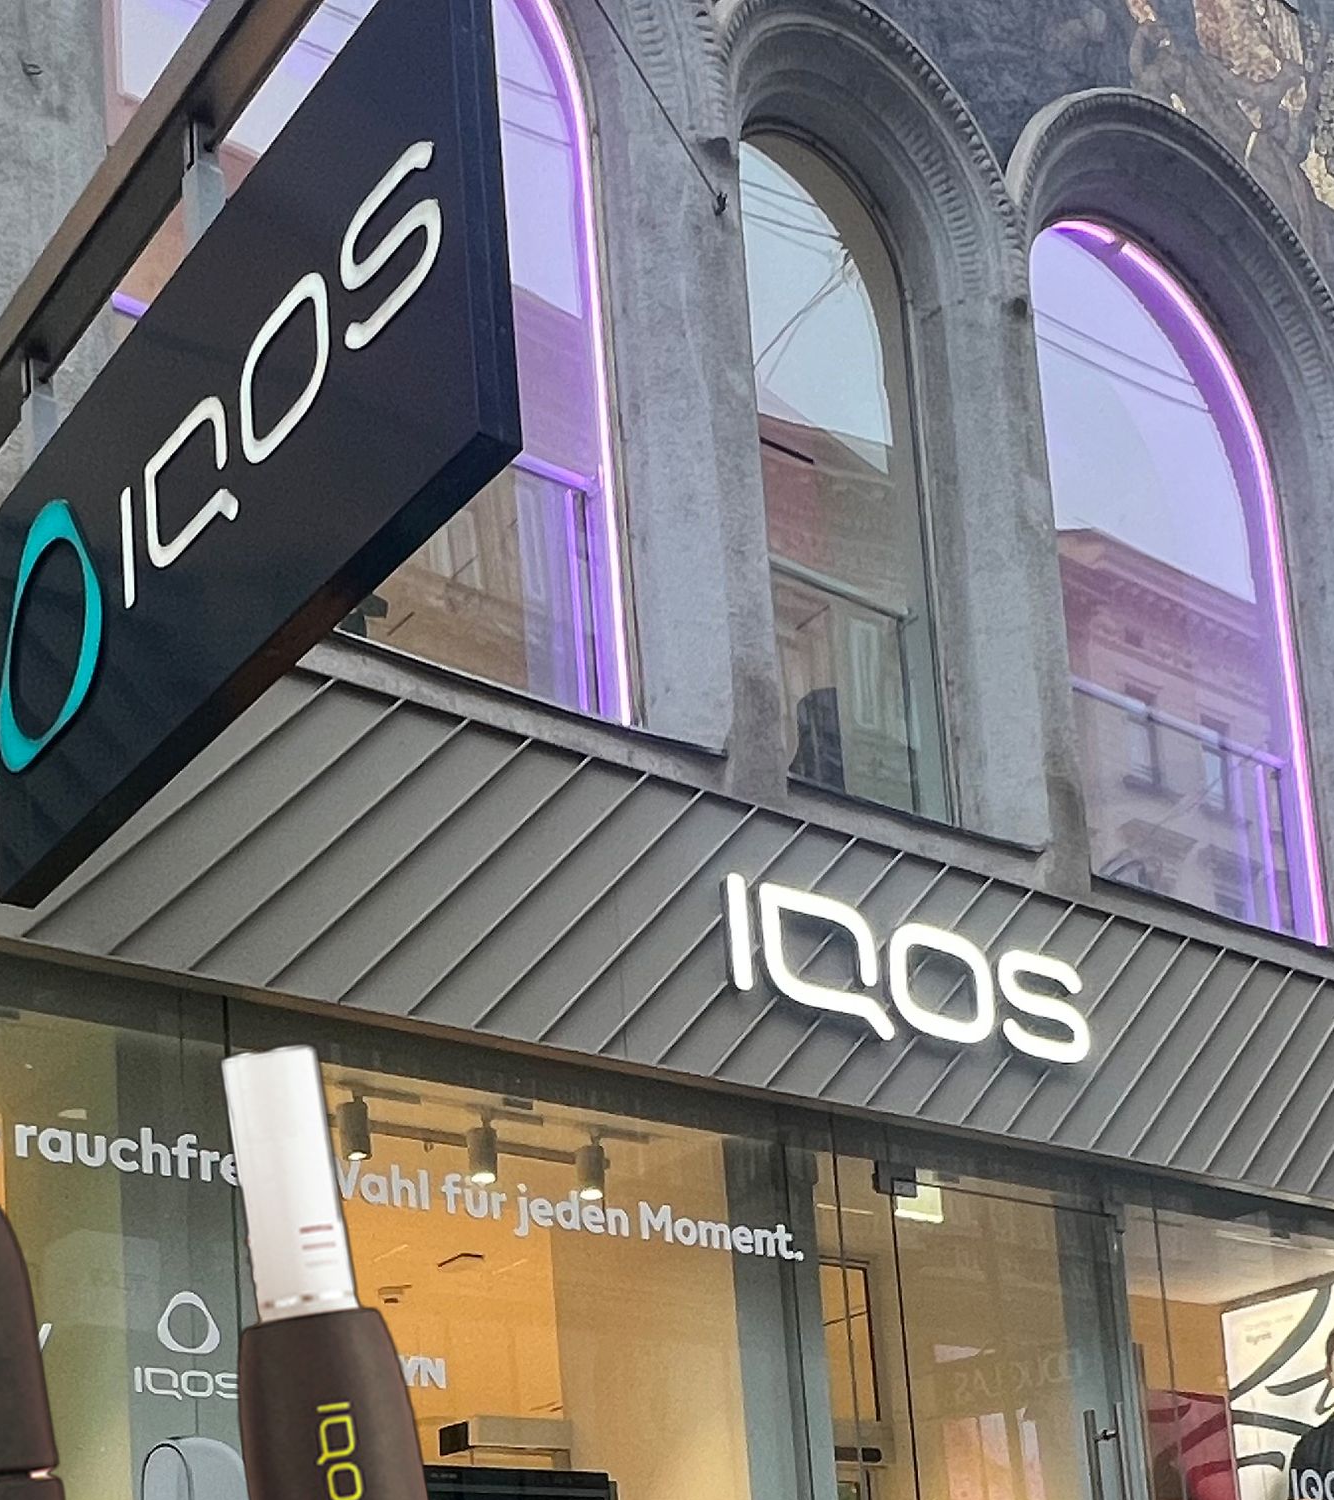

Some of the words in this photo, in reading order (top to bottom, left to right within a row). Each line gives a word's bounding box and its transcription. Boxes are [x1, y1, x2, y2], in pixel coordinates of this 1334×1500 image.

[119, 140, 441, 608] IQOS
[725, 872, 1091, 1064] IQOS
[14, 1124, 241, 1187] rauchfre
[441, 1173, 507, 1220] für
[514, 1183, 630, 1238] jeden
[639, 1200, 805, 1262] Moment.
[133, 1365, 239, 1401] IQOS
[398, 1355, 447, 1390] YN
